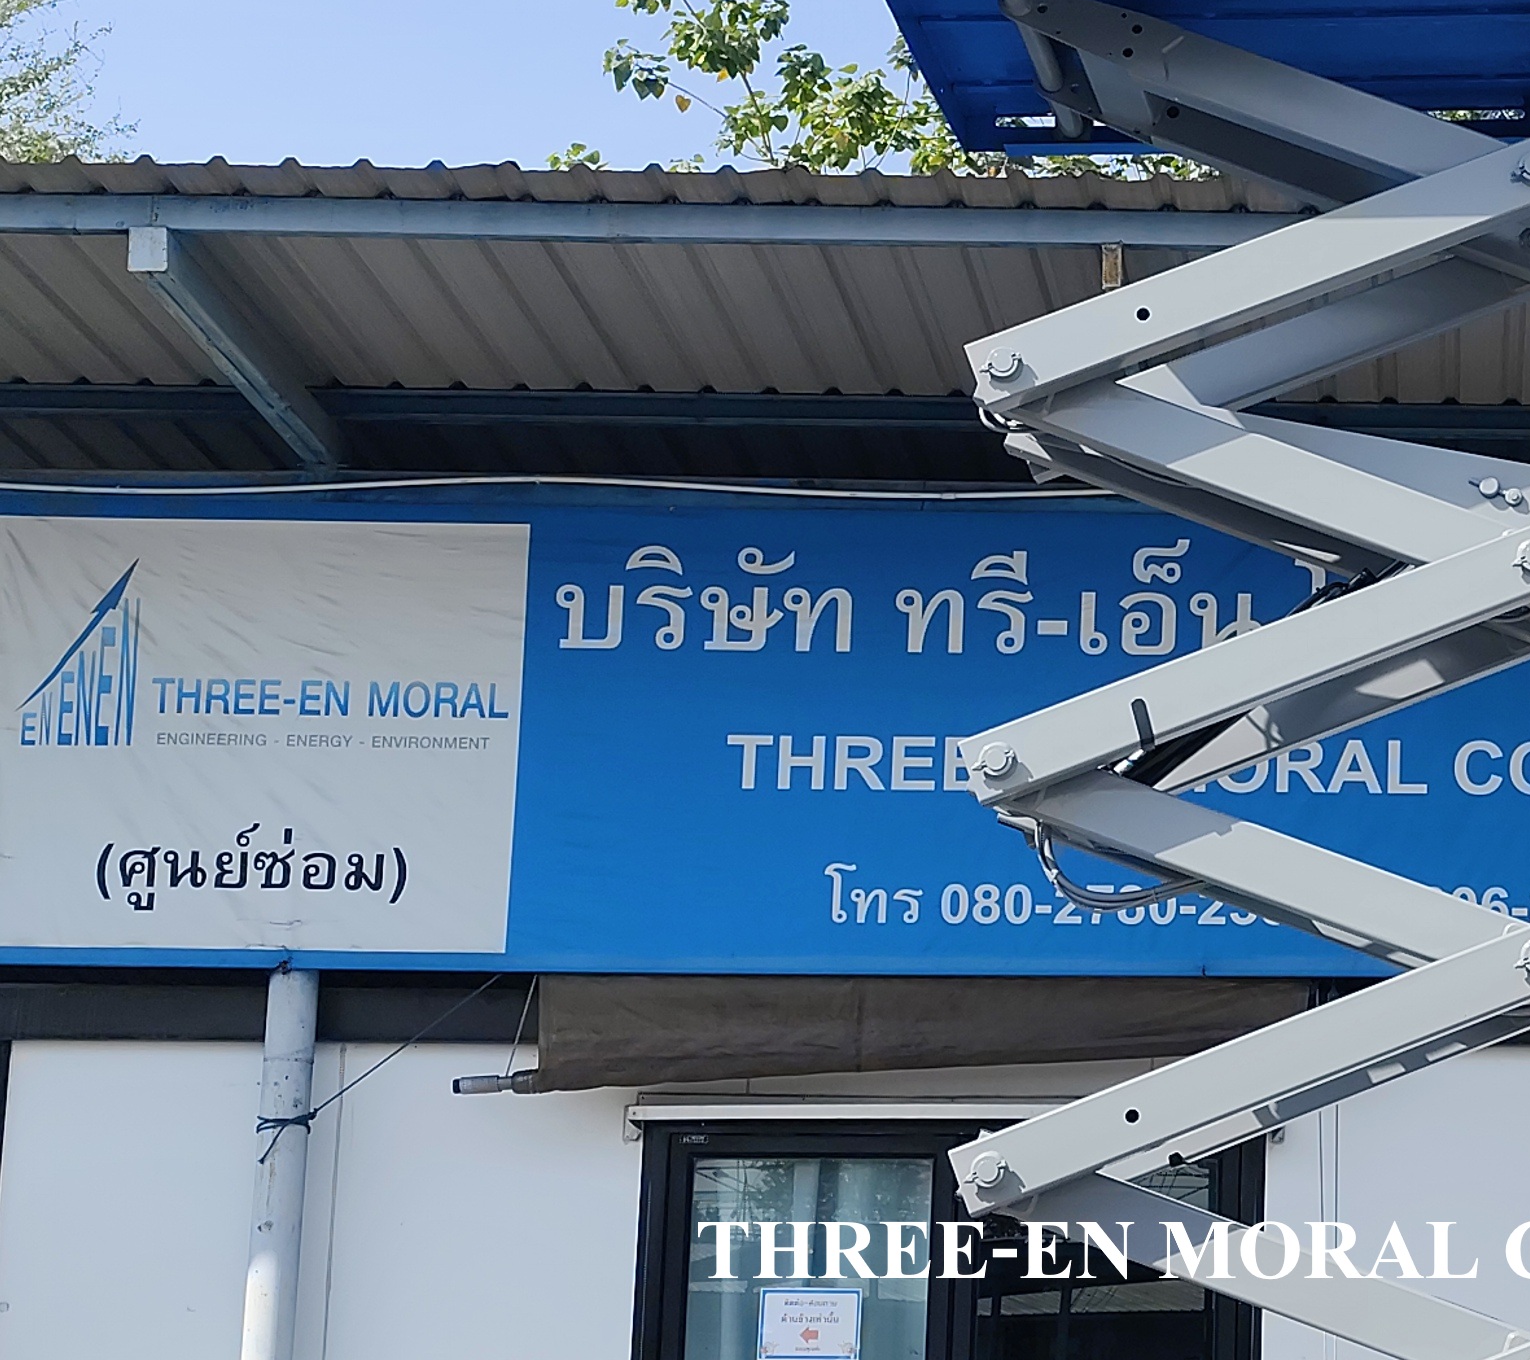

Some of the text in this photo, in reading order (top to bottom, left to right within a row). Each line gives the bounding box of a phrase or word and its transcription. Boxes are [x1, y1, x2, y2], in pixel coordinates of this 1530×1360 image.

[555, 545, 854, 652] บริษัท
[895, 538, 1263, 655] ทรี-เอ็น
[152, 677, 510, 720] THREE-EN MORAL
[156, 732, 268, 747] ENGINEERING
[286, 735, 353, 749] ENERGY
[371, 736, 490, 750] ENVIRONMENT
[1194, 739, 1429, 795] ORAL
[96, 823, 408, 911] (ศูนย์ซ่อม)
[824, 863, 922, 924] โทร
